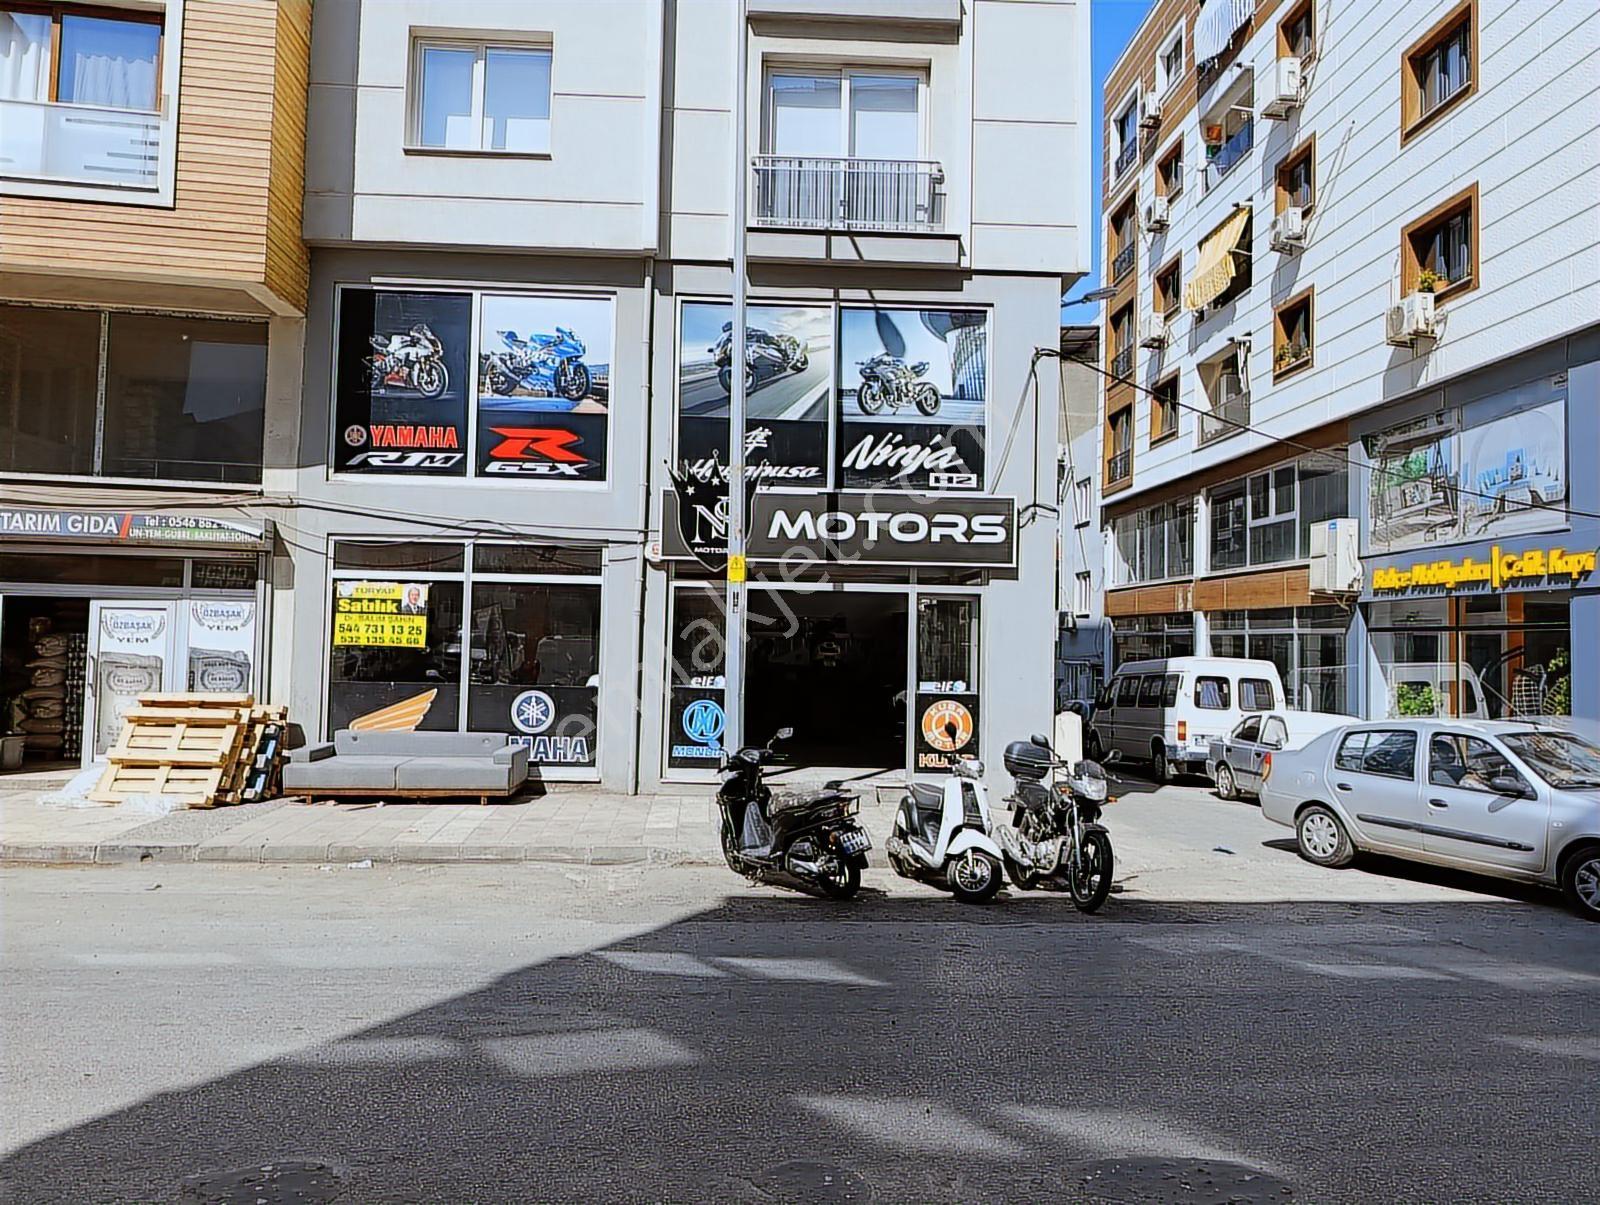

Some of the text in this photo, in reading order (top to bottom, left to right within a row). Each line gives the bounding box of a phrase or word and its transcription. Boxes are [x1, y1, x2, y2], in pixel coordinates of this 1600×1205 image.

[370, 425, 459, 448] YAMAHA
[841, 432, 964, 480] Ninja
[484, 461, 589, 476] GSX
[0, 512, 119, 534] TARIM GIDA
[144, 516, 159, 527] Tel
[767, 510, 1008, 544] MOTORS
[338, 598, 399, 613] Satılık
[207, 624, 239, 632] YEM
[365, 624, 385, 634] 731
[391, 625, 404, 635] 13
[408, 625, 423, 636] 25
[116, 636, 149, 644] YEM
